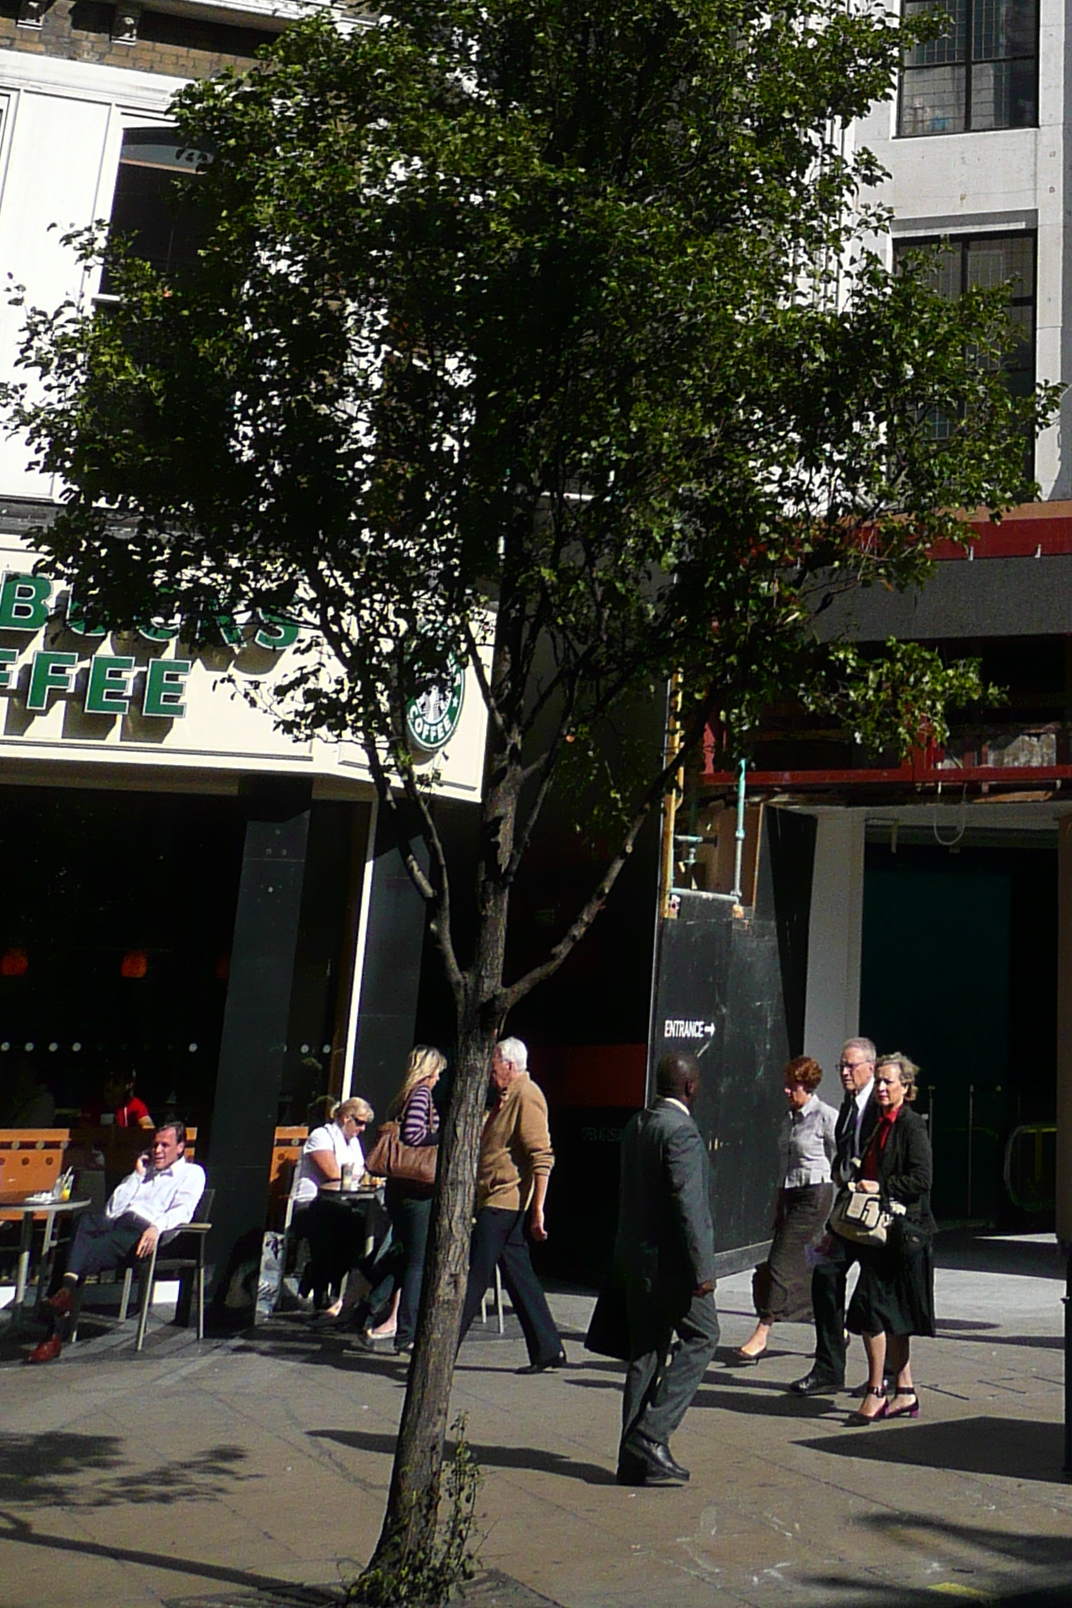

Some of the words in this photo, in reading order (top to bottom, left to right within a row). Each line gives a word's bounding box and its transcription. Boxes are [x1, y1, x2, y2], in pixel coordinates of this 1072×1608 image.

[0, 571, 300, 650] BUS
[409, 704, 452, 742] COFFEE
[664, 1019, 705, 1038] ENTRANCE
